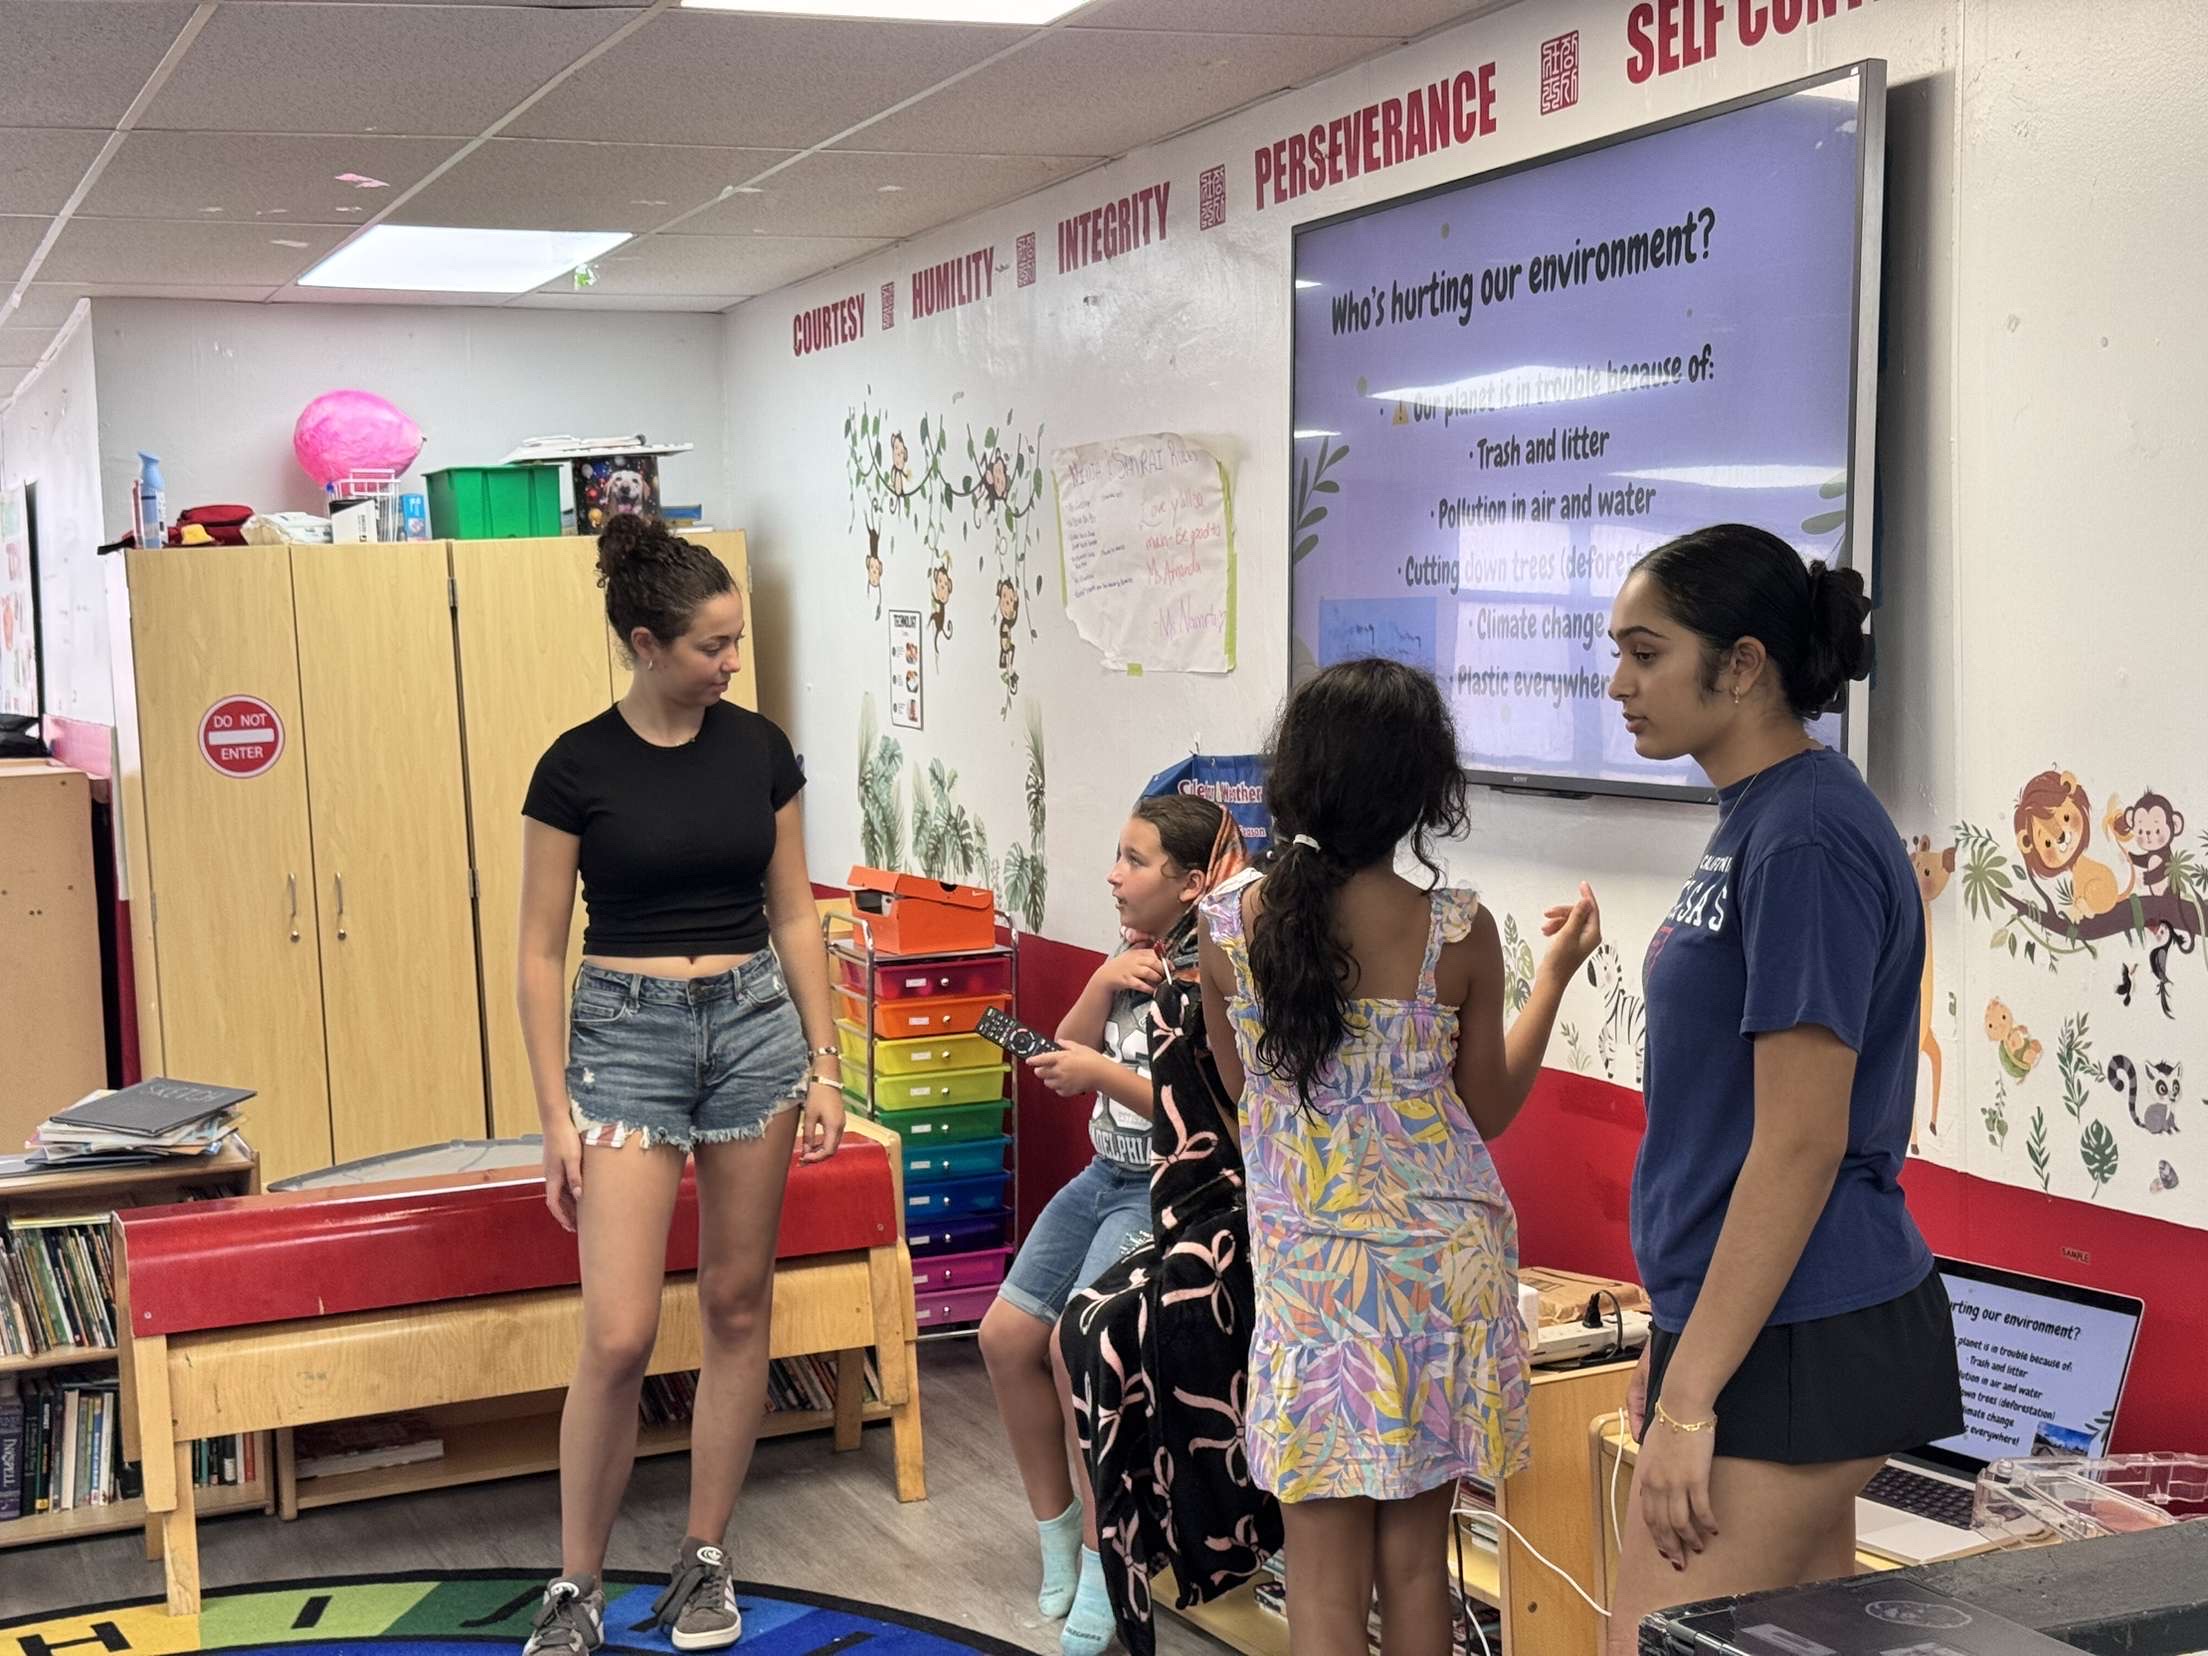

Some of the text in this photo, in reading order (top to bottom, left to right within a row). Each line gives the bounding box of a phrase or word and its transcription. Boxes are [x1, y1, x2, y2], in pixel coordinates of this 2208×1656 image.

[1626, 0, 1725, 84] SELF
[1254, 62, 1497, 210] PERSEVERANCE
[1057, 181, 1171, 275] INTEGRITY
[911, 246, 995, 320] HUMILITY
[1331, 207, 1716, 336] Who's hurting our environment?
[793, 293, 866, 357] COURTESY
[1413, 343, 1715, 428] Our planet is in trouble because of:
[1476, 426, 1611, 470] Trash and litter
[1438, 482, 1657, 530] Pollution in air and water
[1405, 554, 1460, 595] Cutting
[1465, 550, 1507, 584] down
[1512, 551, 1556, 583] trees
[1477, 604, 1606, 650] Climate change
[1457, 663, 1611, 706] Plastic everywher
[213, 713, 267, 728] DO NOT
[221, 746, 264, 760] ENTER
[2061, 1247, 2089, 1263] SAMPLE
[1951, 1300, 2081, 1342] rting our environment?
[1957, 1337, 1982, 1351] planet
[1983, 1343, 1990, 1352] is
[1991, 1344, 1998, 1353] in
[2000, 1346, 2028, 1361] trouble
[2029, 1352, 2060, 1369] because
[1969, 1355, 2028, 1378] Trash and litter
[1978, 1392, 1997, 1406] trees
[1981, 1377, 1988, 1385] in
[1990, 1378, 2002, 1388] air
[2003, 1381, 2018, 1393] and
[2019, 1386, 2043, 1399] water
[1970, 1425, 2020, 1446] everywhere!
[1987, 1410, 2015, 1429] change
